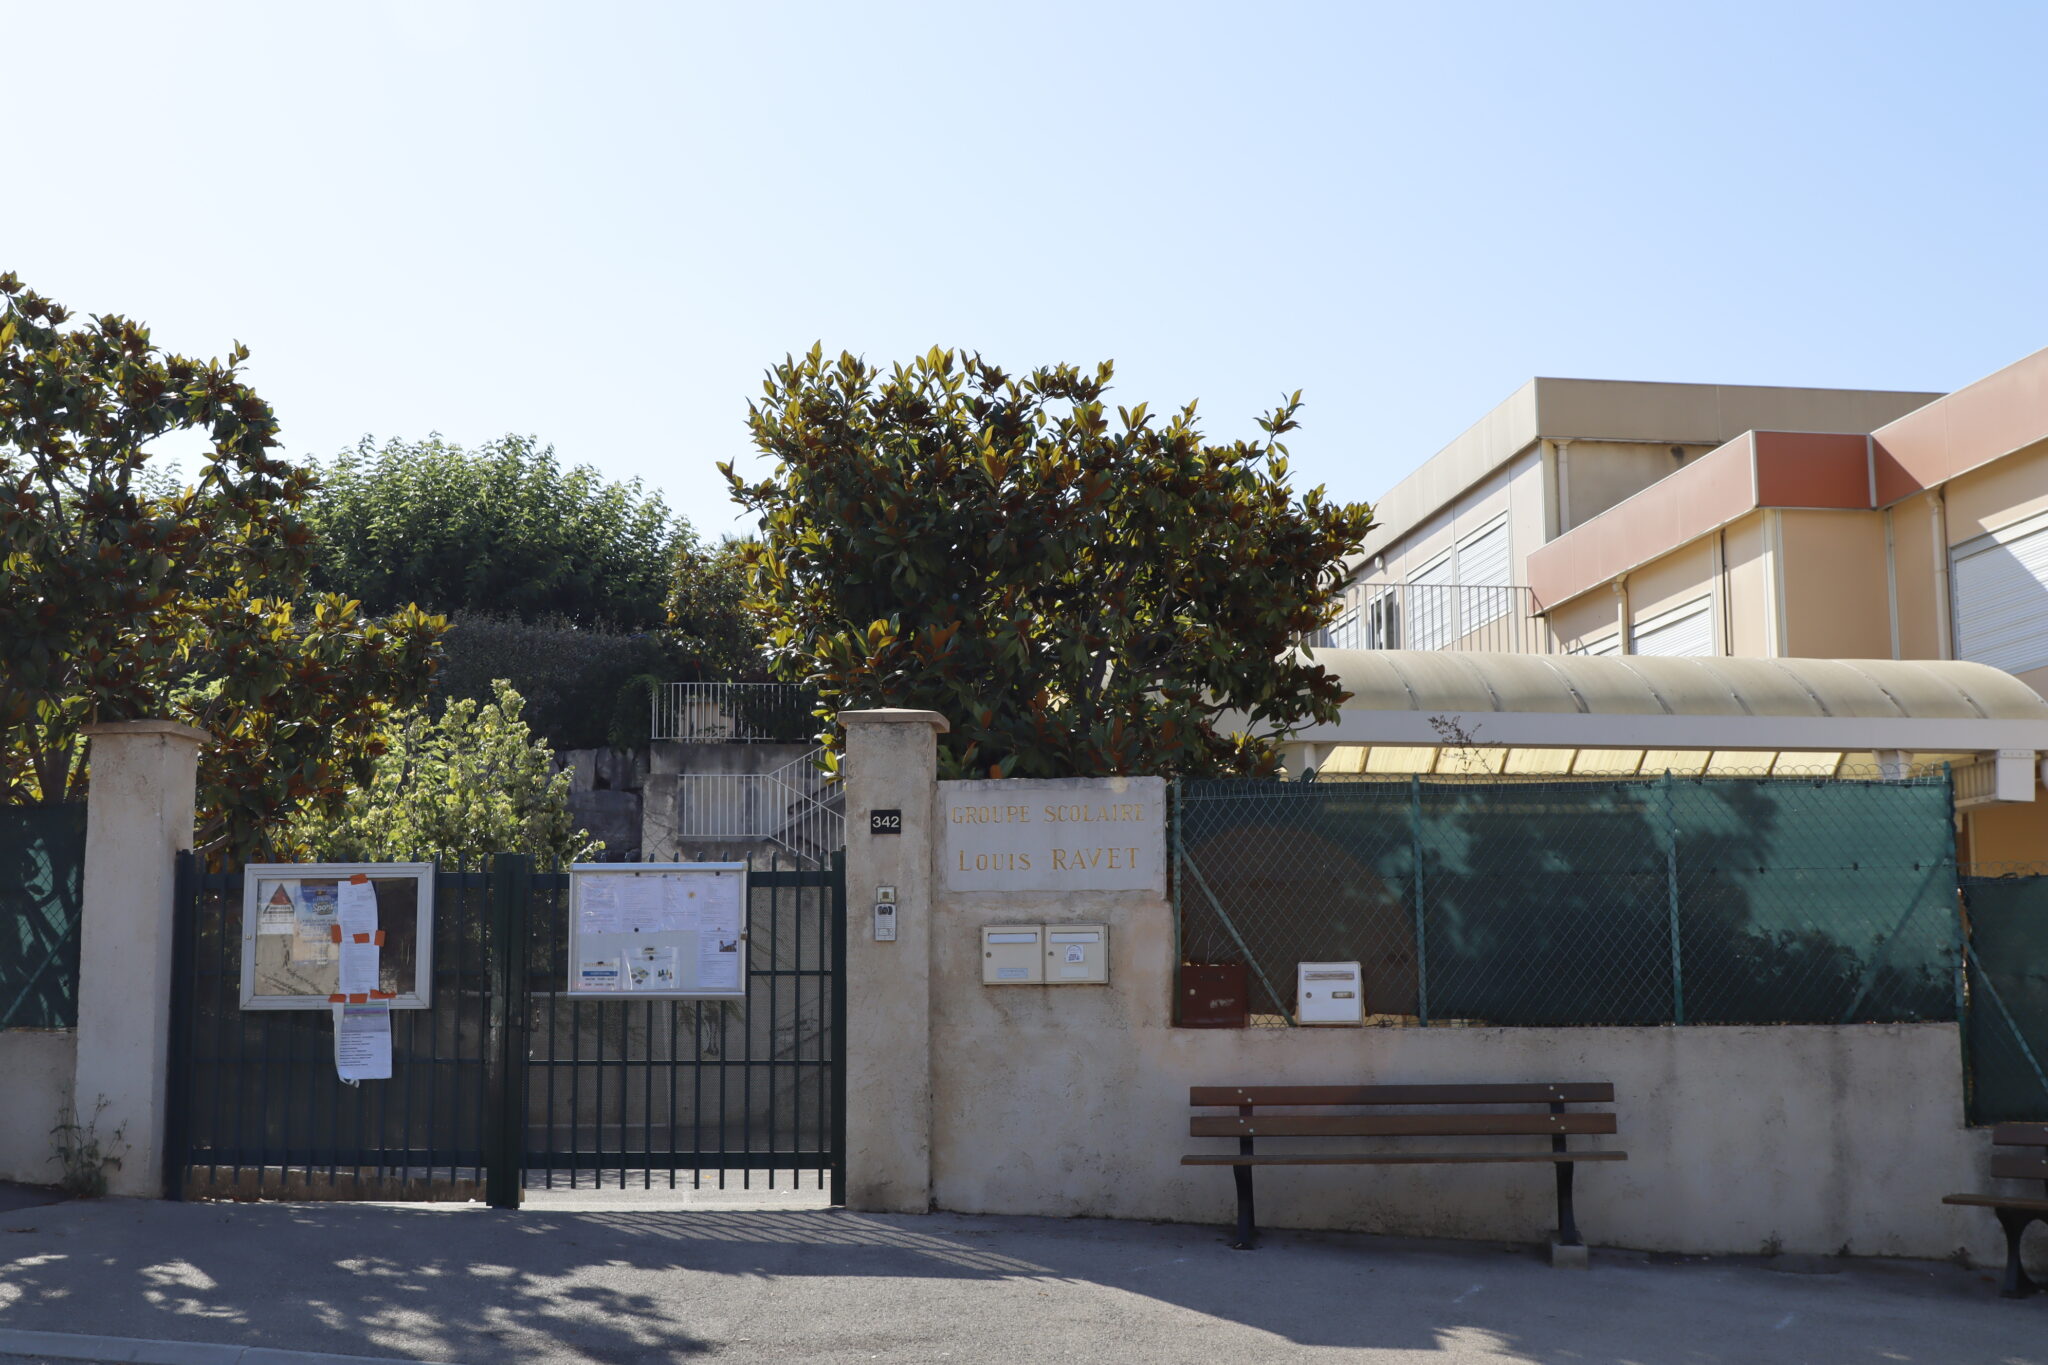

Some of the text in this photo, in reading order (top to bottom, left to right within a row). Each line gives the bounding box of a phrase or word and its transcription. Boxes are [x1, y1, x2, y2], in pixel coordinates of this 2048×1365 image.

[872, 815, 900, 828] 342
[951, 803, 1145, 824] GROUPE SCOLAIRE
[958, 848, 1141, 872] LOUIS RAVET
